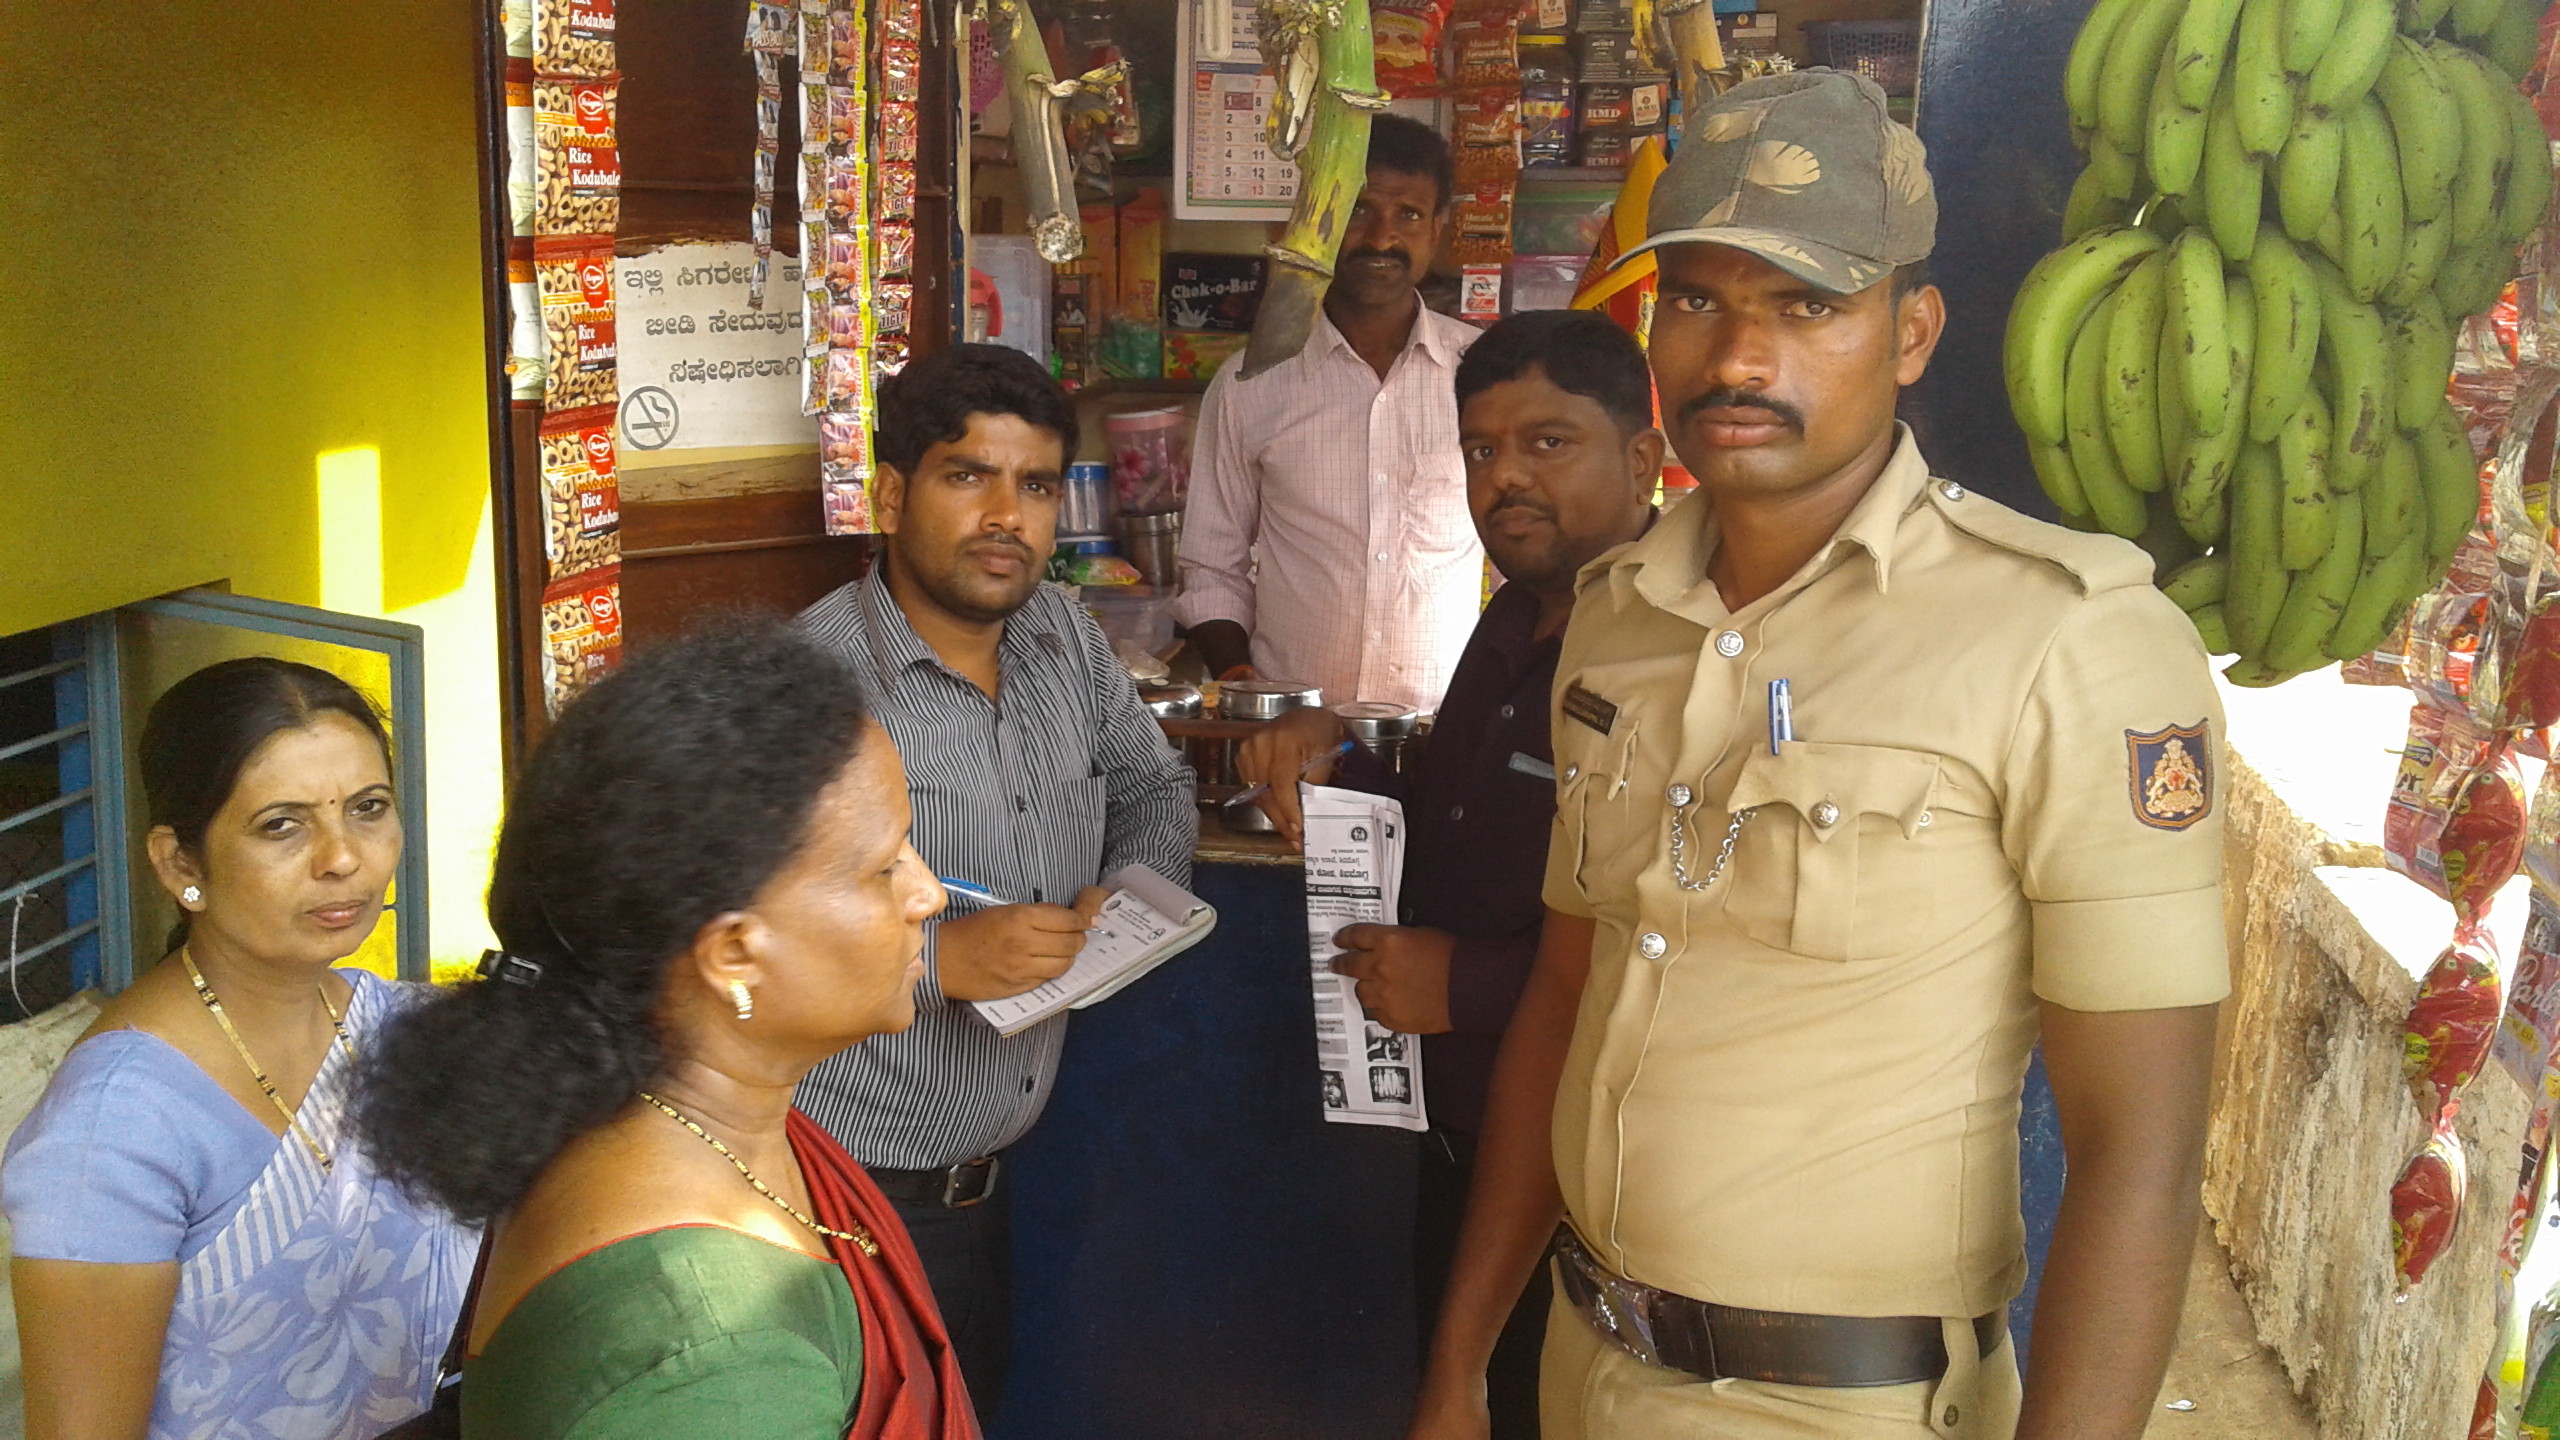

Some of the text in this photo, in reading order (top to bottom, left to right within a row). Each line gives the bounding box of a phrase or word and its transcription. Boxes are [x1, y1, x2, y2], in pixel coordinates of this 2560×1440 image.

[1255, 78, 1262, 88] 7
[1226, 96, 1262, 107] 1 8
[1226, 114, 1262, 125] 2 9
[1586, 108, 1622, 118] RMD
[1226, 131, 1266, 143] 3 10
[569, 147, 592, 164] Rice
[1225, 149, 1265, 160] 4 11
[573, 169, 620, 186] Kodubale
[1225, 167, 1293, 178] 5 12 19
[1224, 184, 1292, 196] 6 13 20
[624, 268, 664, 296] ಇಲ್ಲಿ
[578, 324, 595, 340] Rice
[645, 314, 696, 336] ಬೀಡಿ
[580, 342, 616, 361] Kodubal
[581, 492, 602, 509] Rice
[587, 651, 605, 669] Rice
